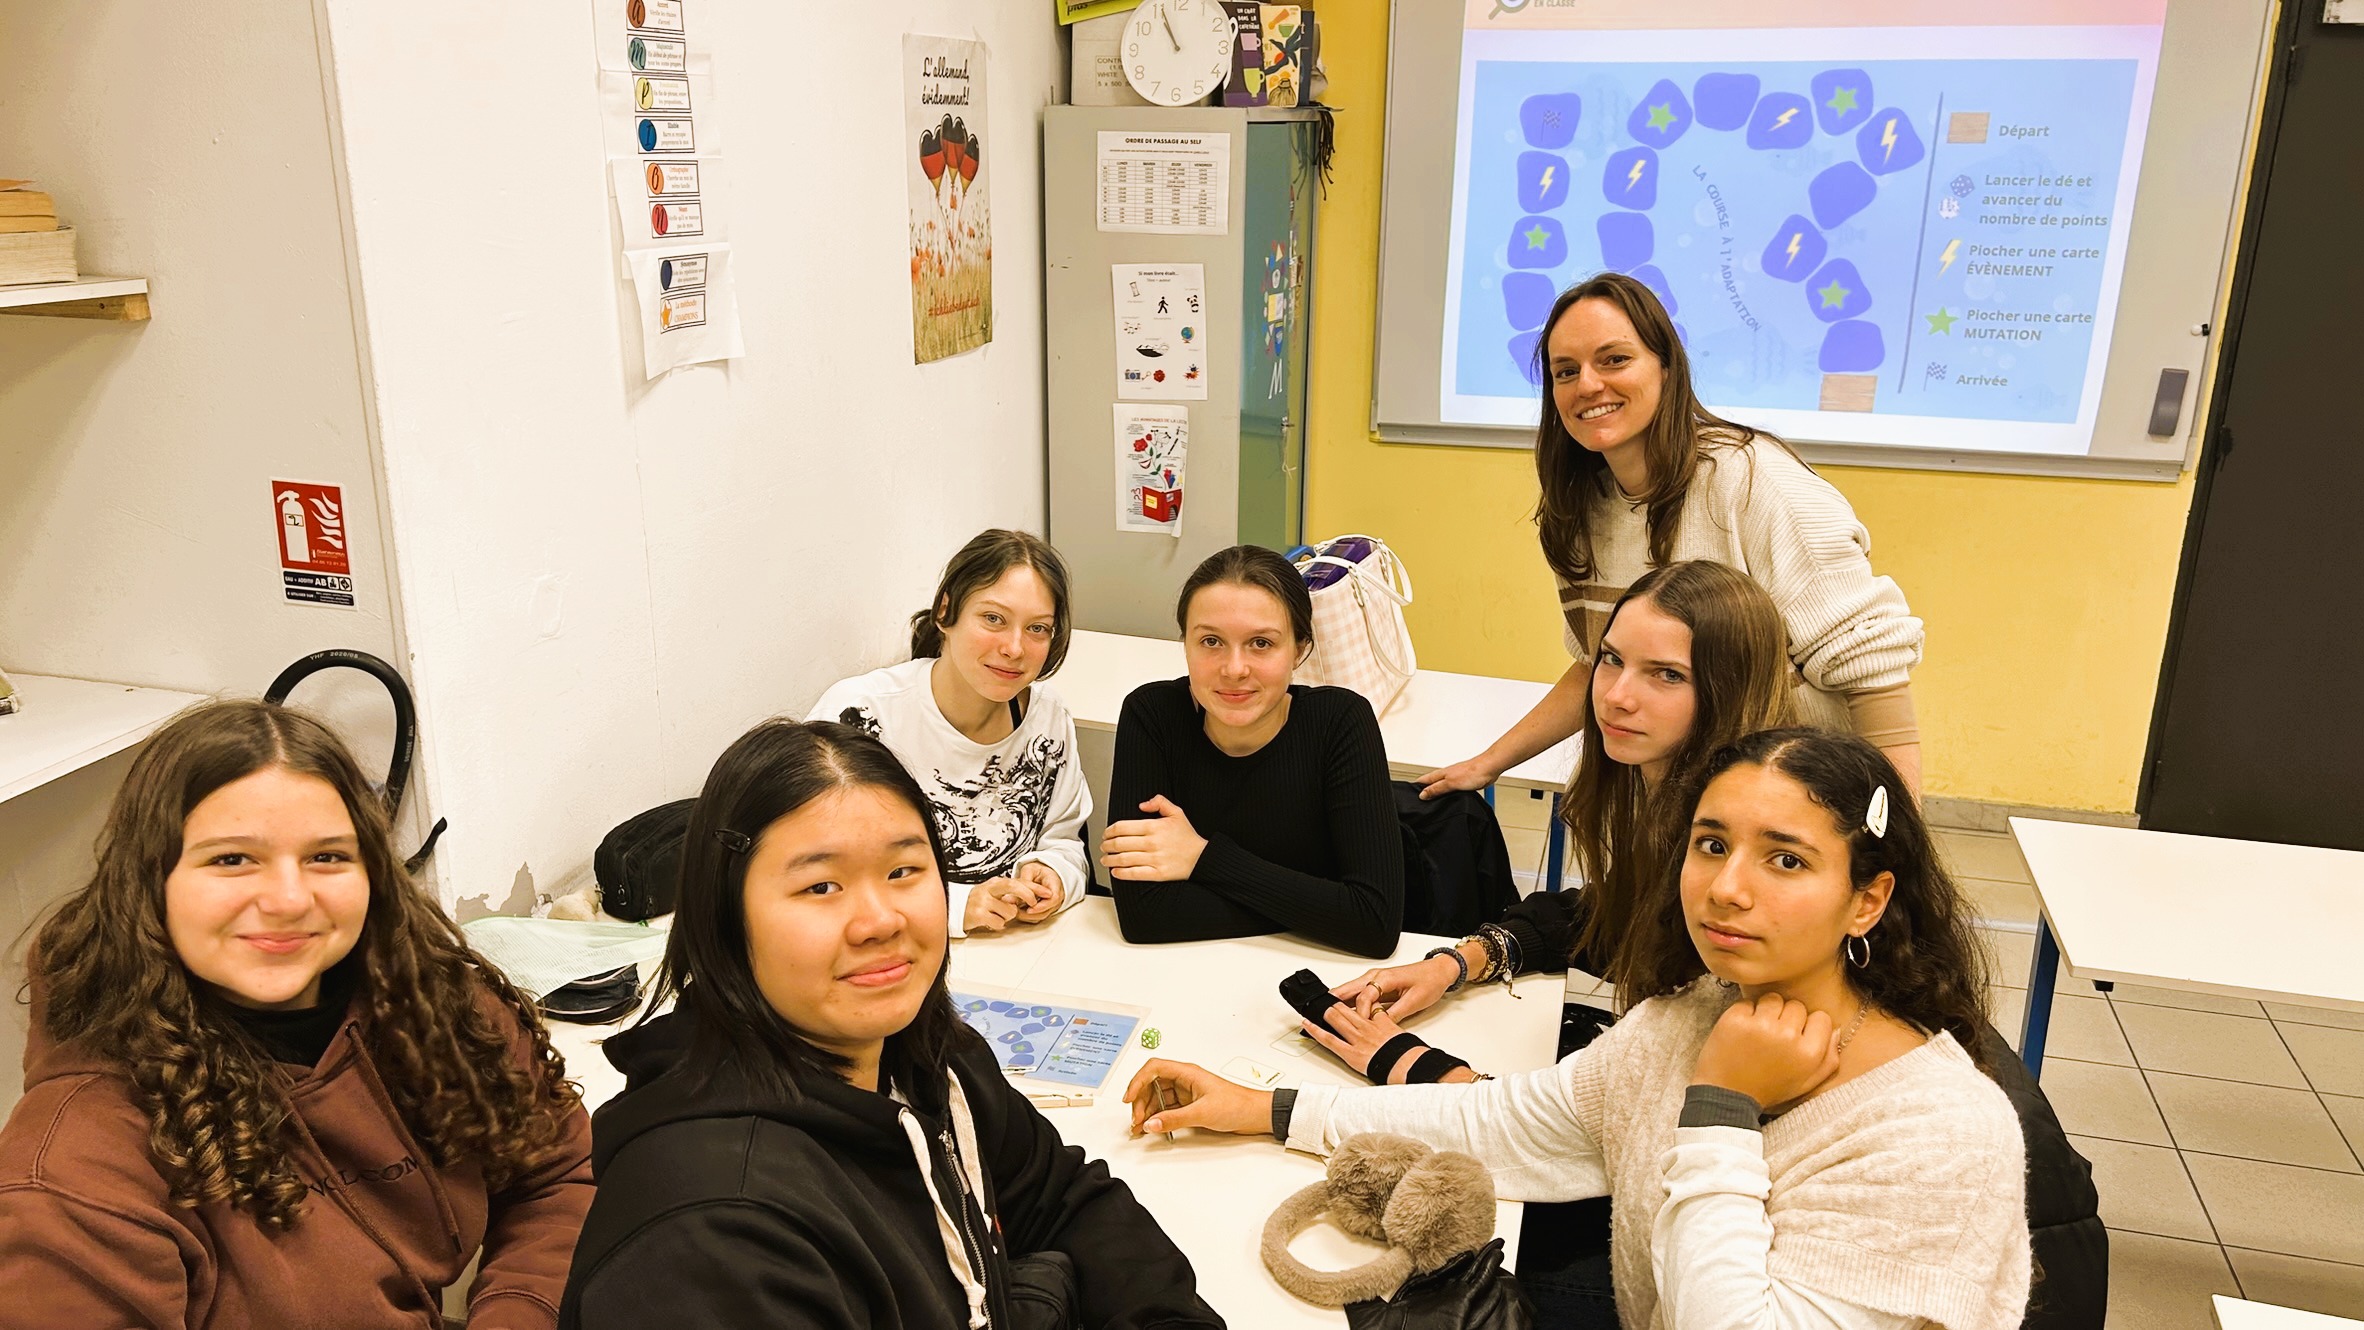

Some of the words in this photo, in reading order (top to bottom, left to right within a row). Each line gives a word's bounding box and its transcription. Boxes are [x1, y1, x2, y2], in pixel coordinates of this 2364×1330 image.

[1174, 0, 1189, 11] 12
[1200, 1, 1206, 17] 1
[1136, 21, 1152, 37] 10
[1212, 17, 1223, 33] 2
[1129, 43, 1139, 58] 9
[1218, 40, 1229, 55] 3
[1134, 65, 1145, 80] 8
[1211, 63, 1221, 79] 4
[1151, 81, 1162, 97] 7
[1171, 87, 1182, 102] 6
[1193, 79, 1204, 95] 5
[1998, 125, 2050, 140] Départ
[1985, 174, 2034, 187] Lancer
[2038, 174, 2051, 187] le
[2055, 175, 2073, 187] dé
[2077, 175, 2093, 187] et
[1692, 165, 1707, 182] LA
[1706, 184, 1730, 230] COURSE
[1982, 195, 2040, 206] avancer
[2044, 195, 2063, 206] du
[1979, 214, 2036, 225] nombre
[2040, 214, 2058, 226] de
[2061, 215, 2108, 229] points
[1969, 244, 2024, 257] Piocher
[2028, 248, 2056, 258] une
[2061, 247, 2100, 258] carte
[1966, 261, 2054, 277] ÉVÈNEMENT
[1967, 309, 2020, 322] Piocher
[2024, 312, 2051, 322] une
[2054, 313, 2092, 323] carte
[1964, 328, 2042, 341] MUTATION
[1956, 374, 2008, 387] Arrivée
[315, 577, 327, 587] AB
